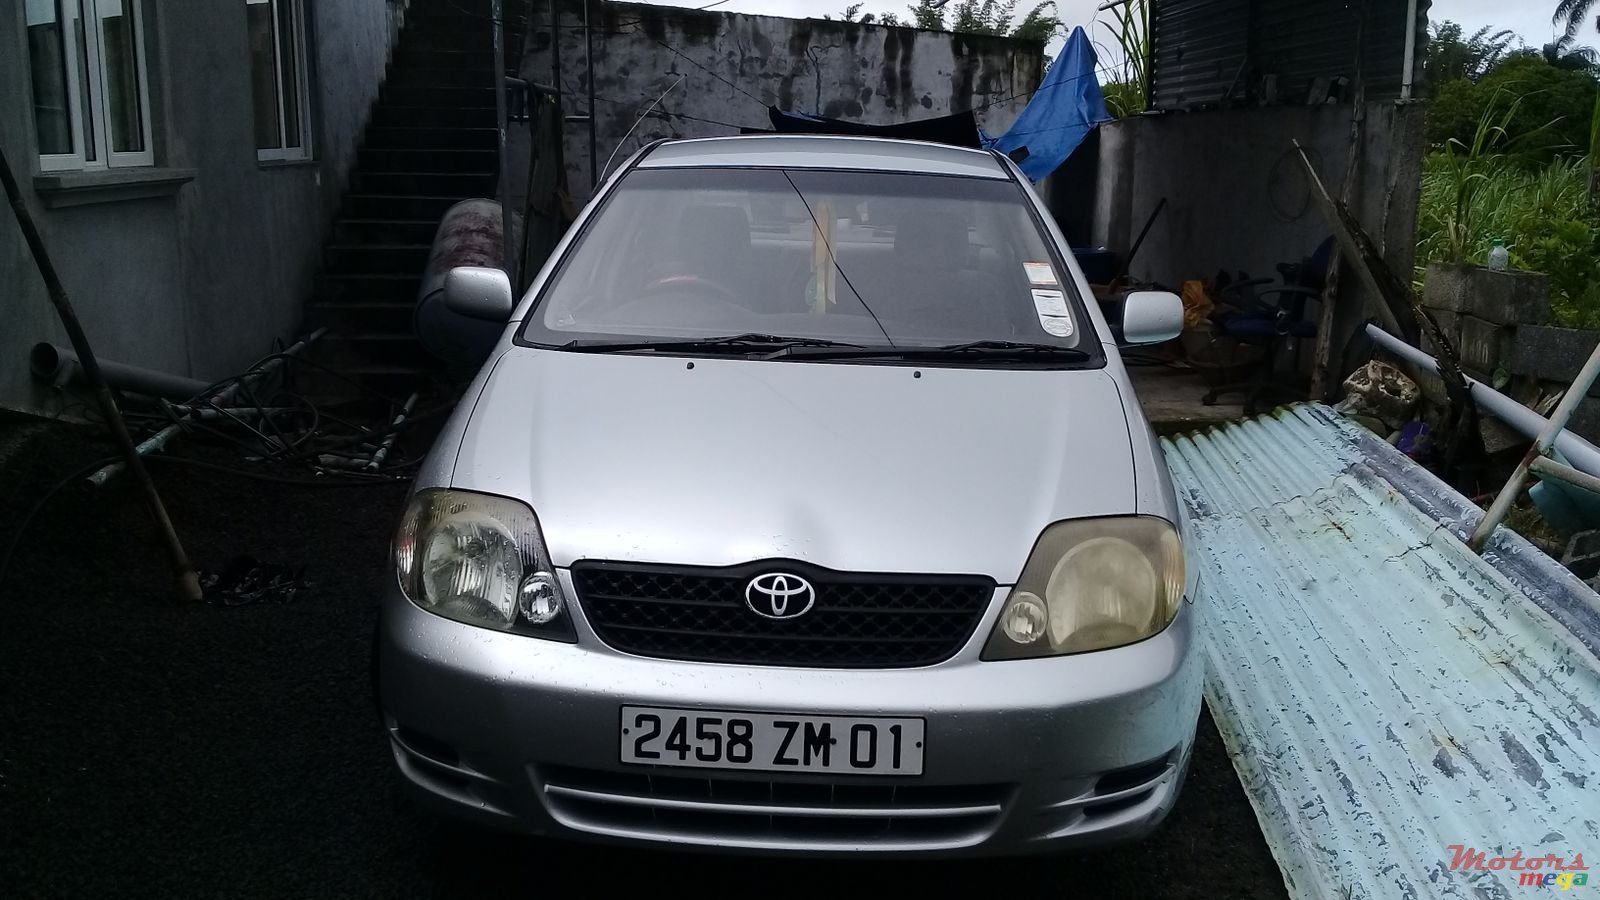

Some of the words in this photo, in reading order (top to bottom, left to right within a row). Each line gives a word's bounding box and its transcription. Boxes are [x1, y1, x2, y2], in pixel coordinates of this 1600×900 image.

[634, 714, 753, 763] 2458
[772, 720, 833, 767] ZM
[849, 723, 902, 769] 01
